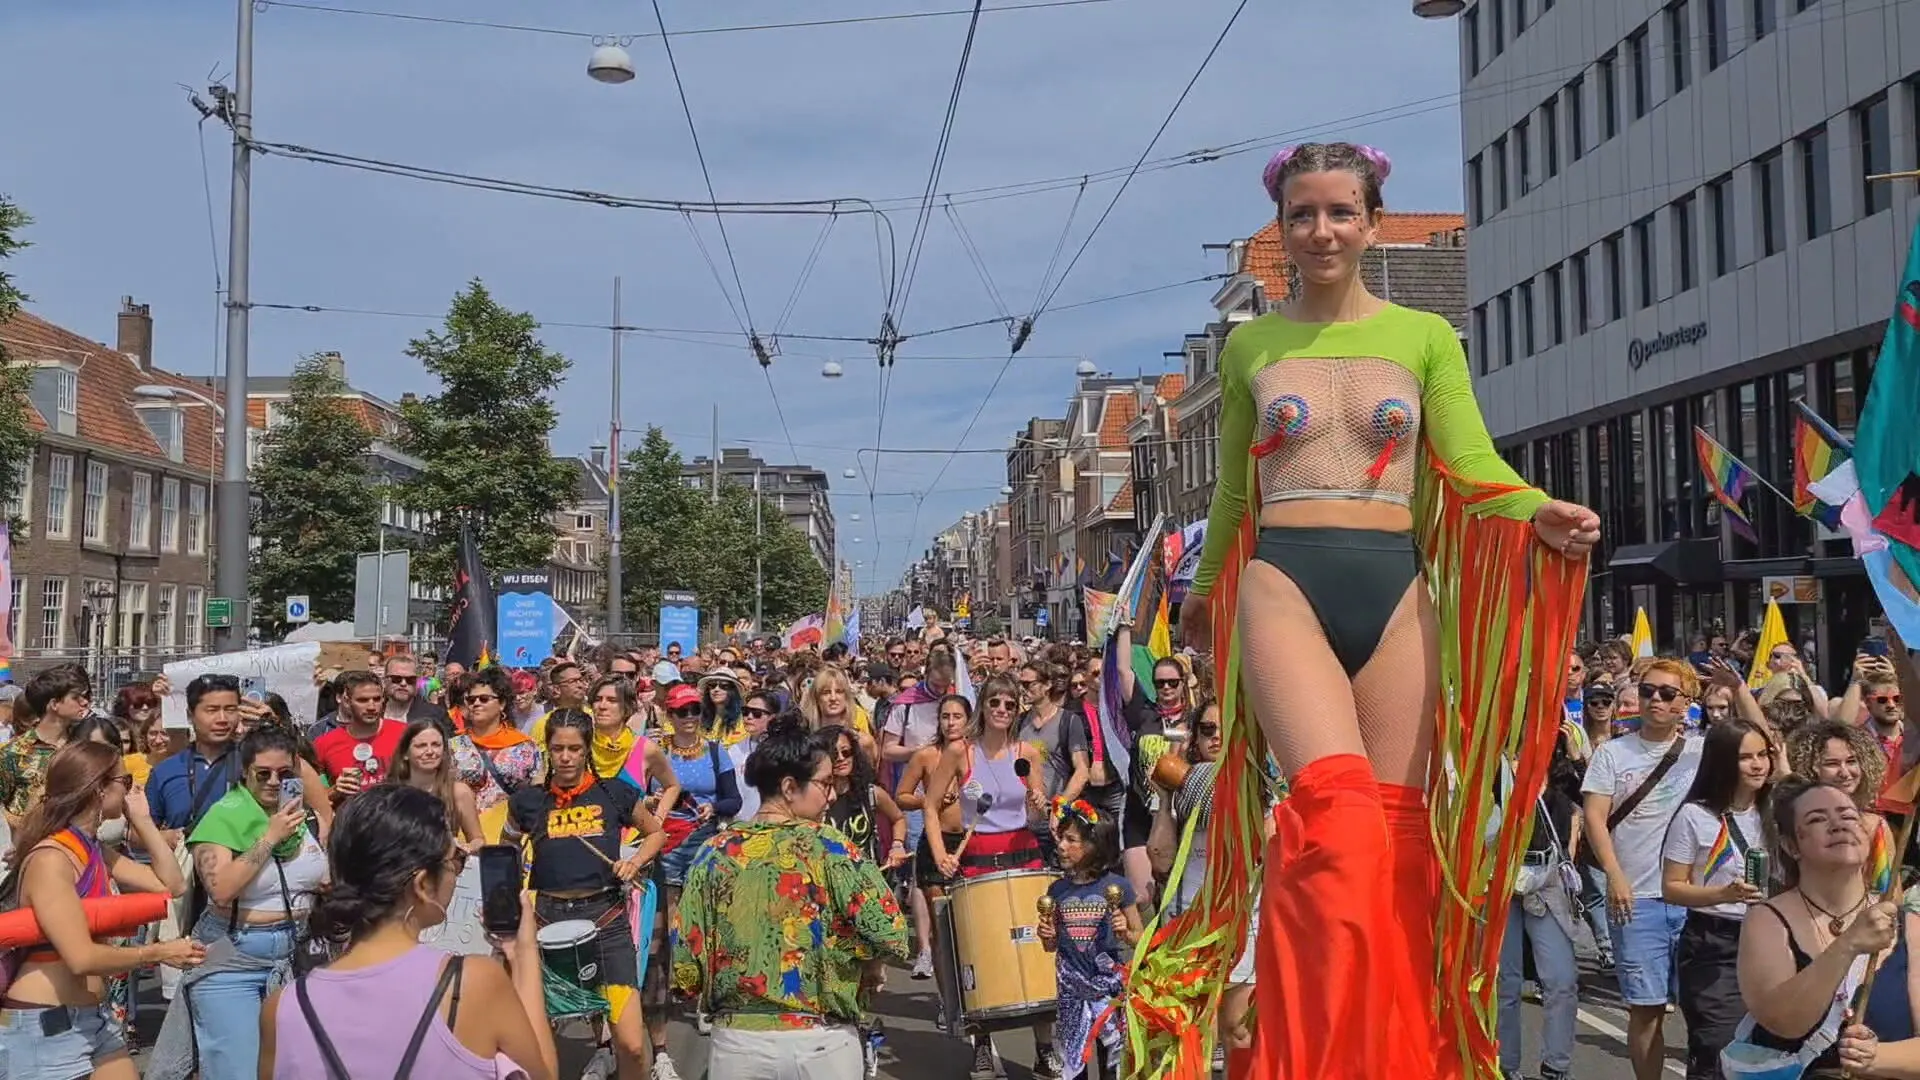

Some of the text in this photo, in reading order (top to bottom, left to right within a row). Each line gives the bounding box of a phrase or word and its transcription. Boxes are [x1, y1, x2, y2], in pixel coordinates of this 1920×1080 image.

[1644, 321, 1707, 362] polarsteps
[503, 575, 549, 584] WIJ EISEN
[548, 804, 603, 824] STOP
